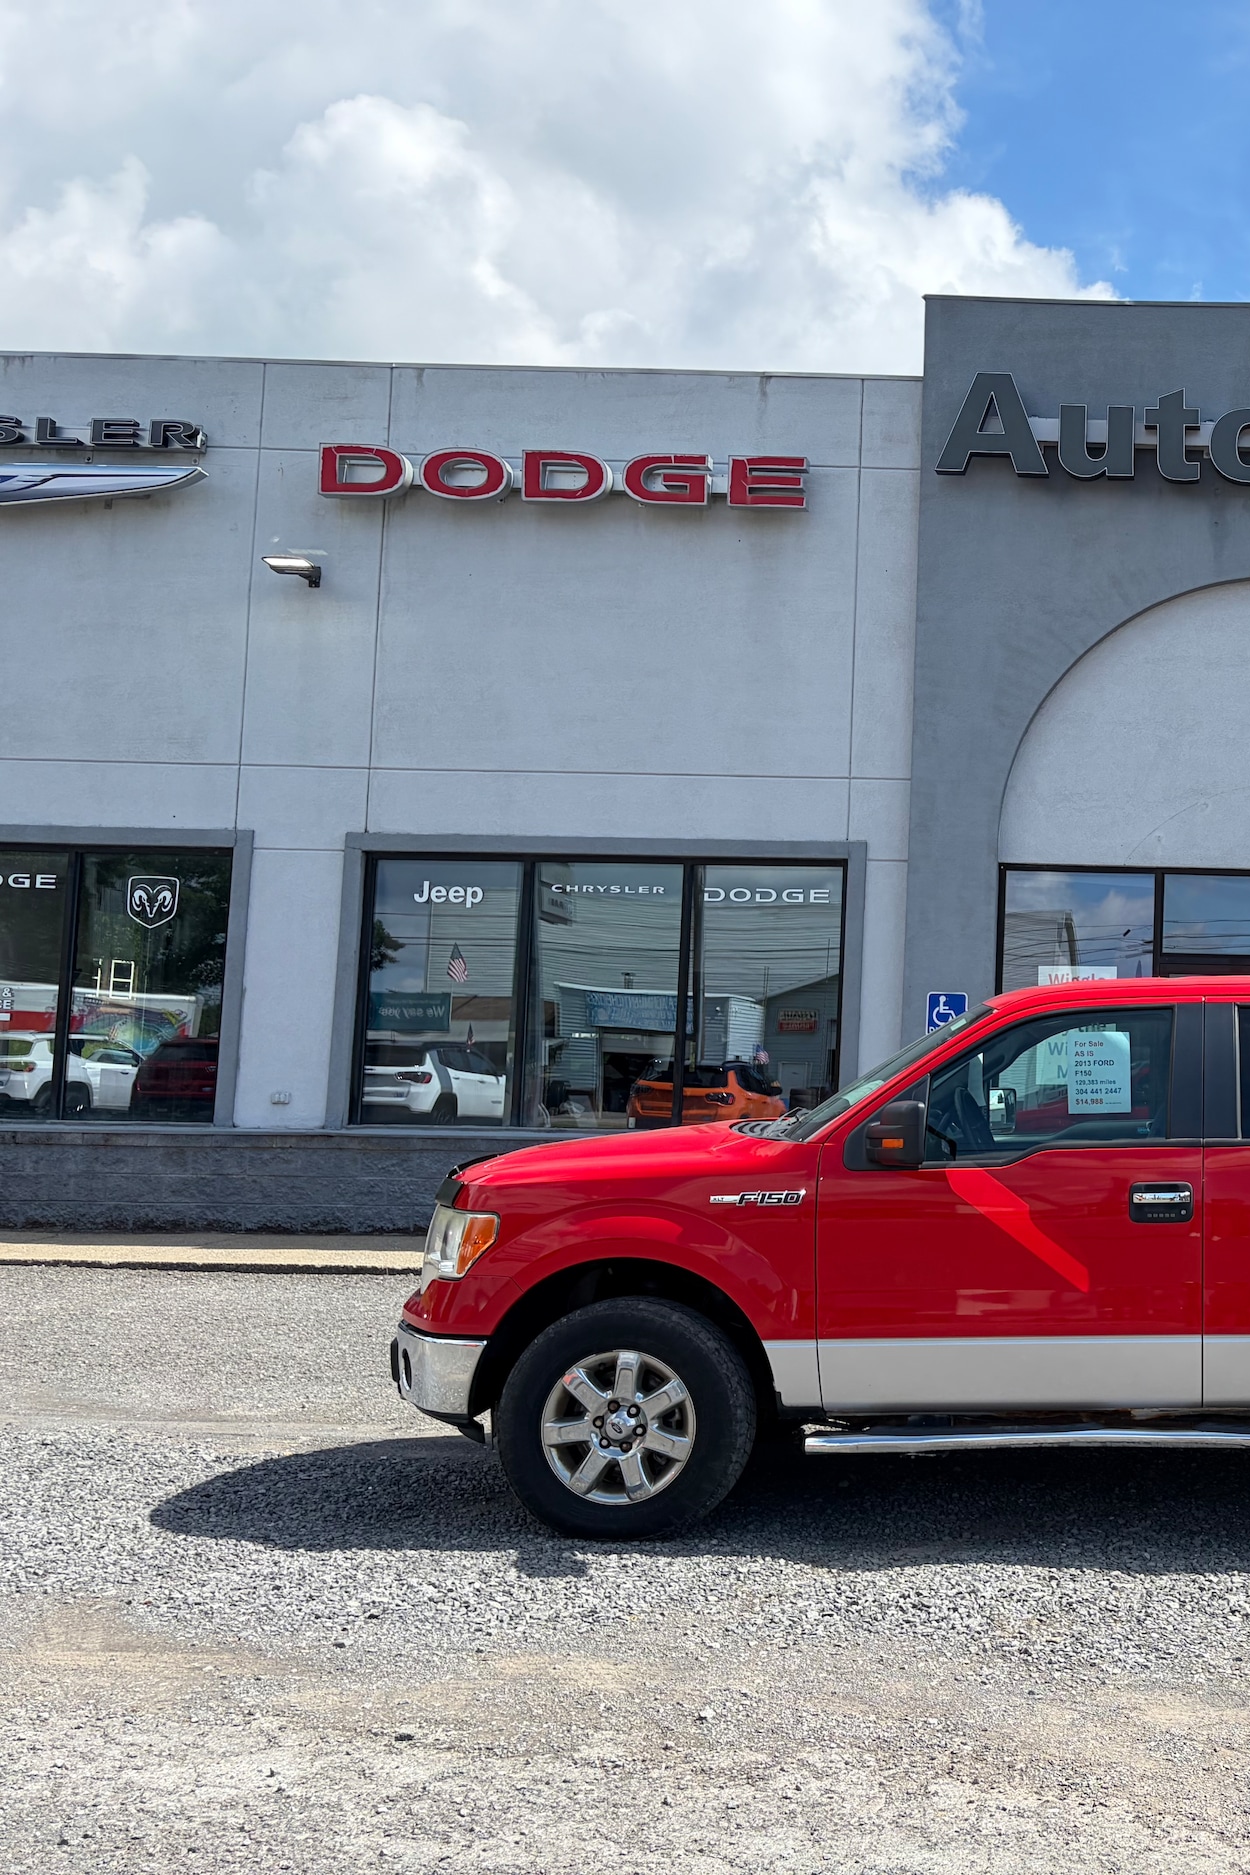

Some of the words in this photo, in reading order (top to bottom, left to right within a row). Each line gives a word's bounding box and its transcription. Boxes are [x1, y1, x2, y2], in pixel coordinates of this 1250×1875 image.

[319, 443, 809, 511] DODGE
[413, 880, 484, 908] Jeep
[551, 883, 665, 895] CHRYSLER
[703, 887, 831, 904] DODGE
[1074, 1040, 1086, 1048] For
[1088, 1040, 1104, 1048] Sale
[1093, 1059, 1115, 1067] FORD
[1104, 1087, 1122, 1095] 2447
